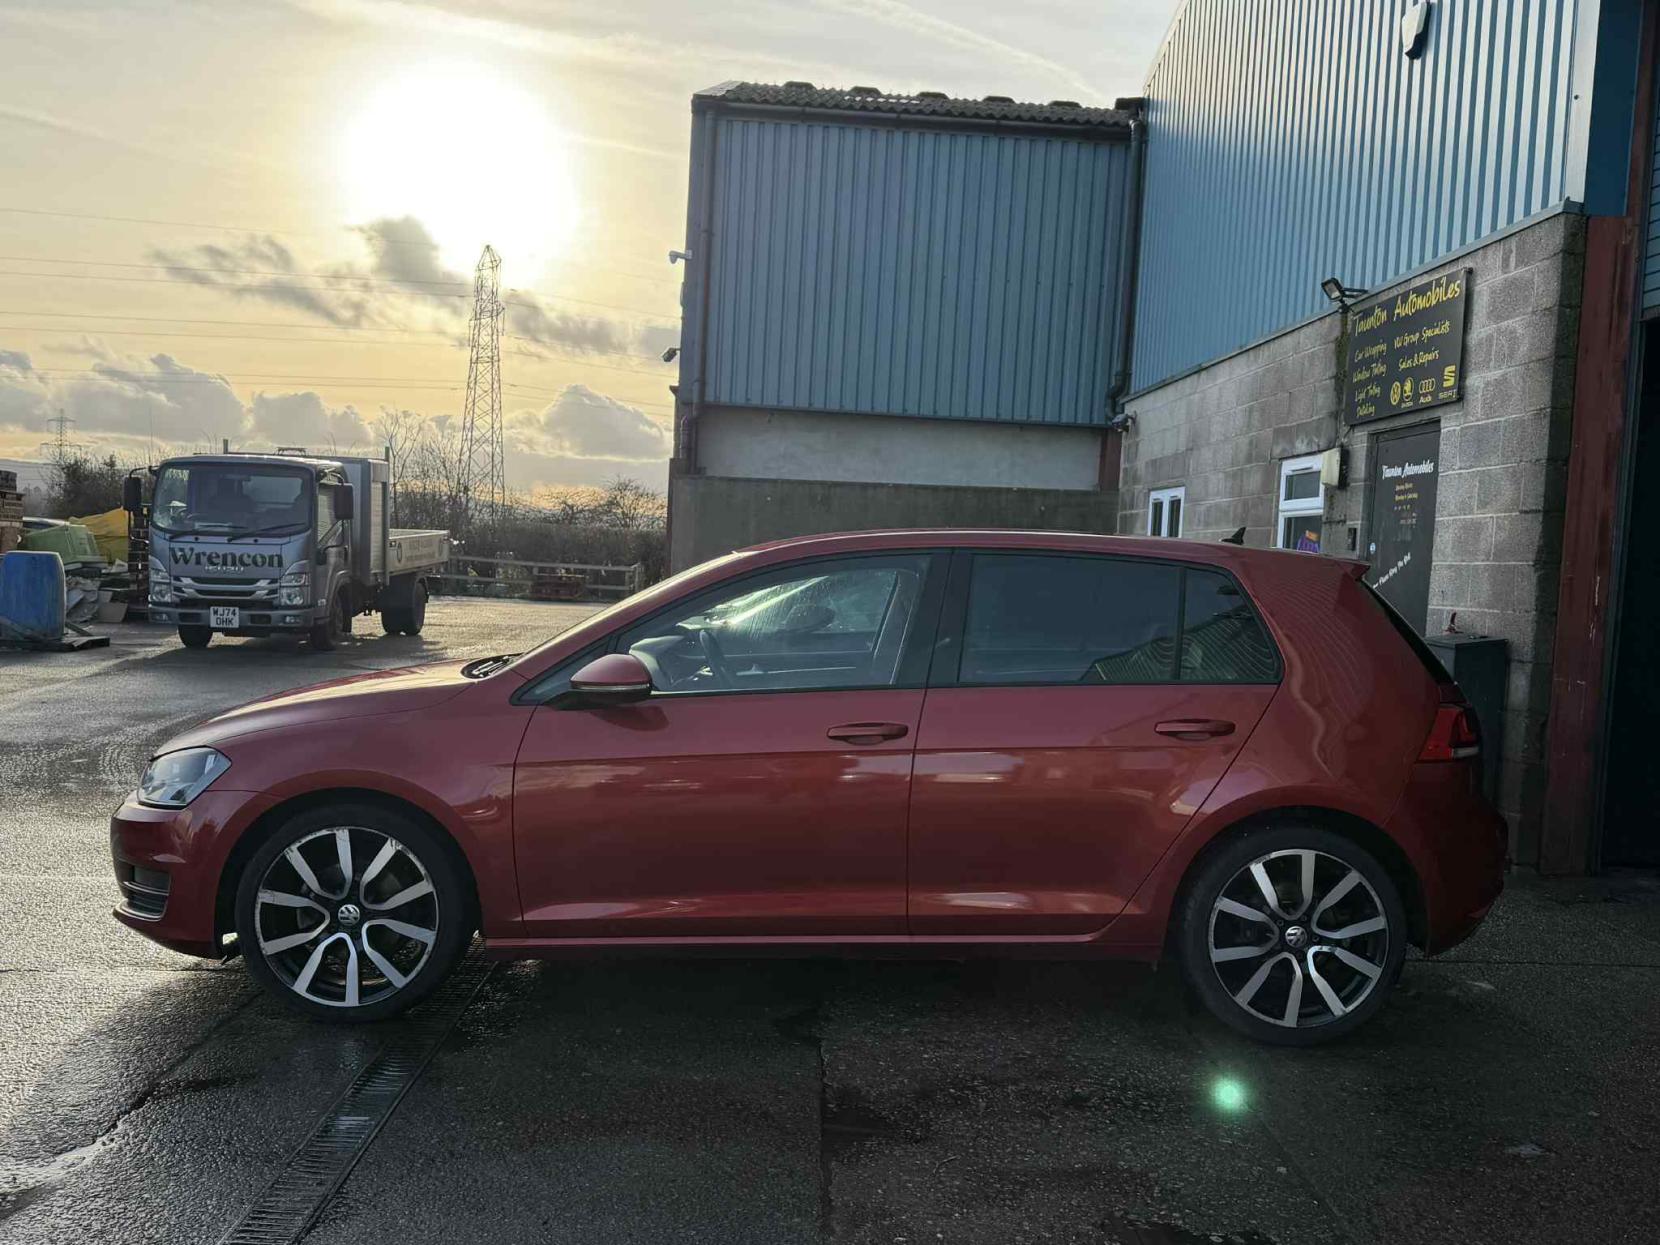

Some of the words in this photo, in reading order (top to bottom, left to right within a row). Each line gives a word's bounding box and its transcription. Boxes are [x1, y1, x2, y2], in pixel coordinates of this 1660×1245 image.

[1353, 306, 1387, 336] Taunton
[1393, 276, 1460, 321] Automobiles
[1403, 332, 1419, 346] Group
[1421, 319, 1450, 342] Specialists
[1398, 355, 1413, 371] Sales
[1418, 346, 1440, 367] Repairs
[170, 547, 283, 567] Wrencon
[212, 608, 237, 616] WJ74
